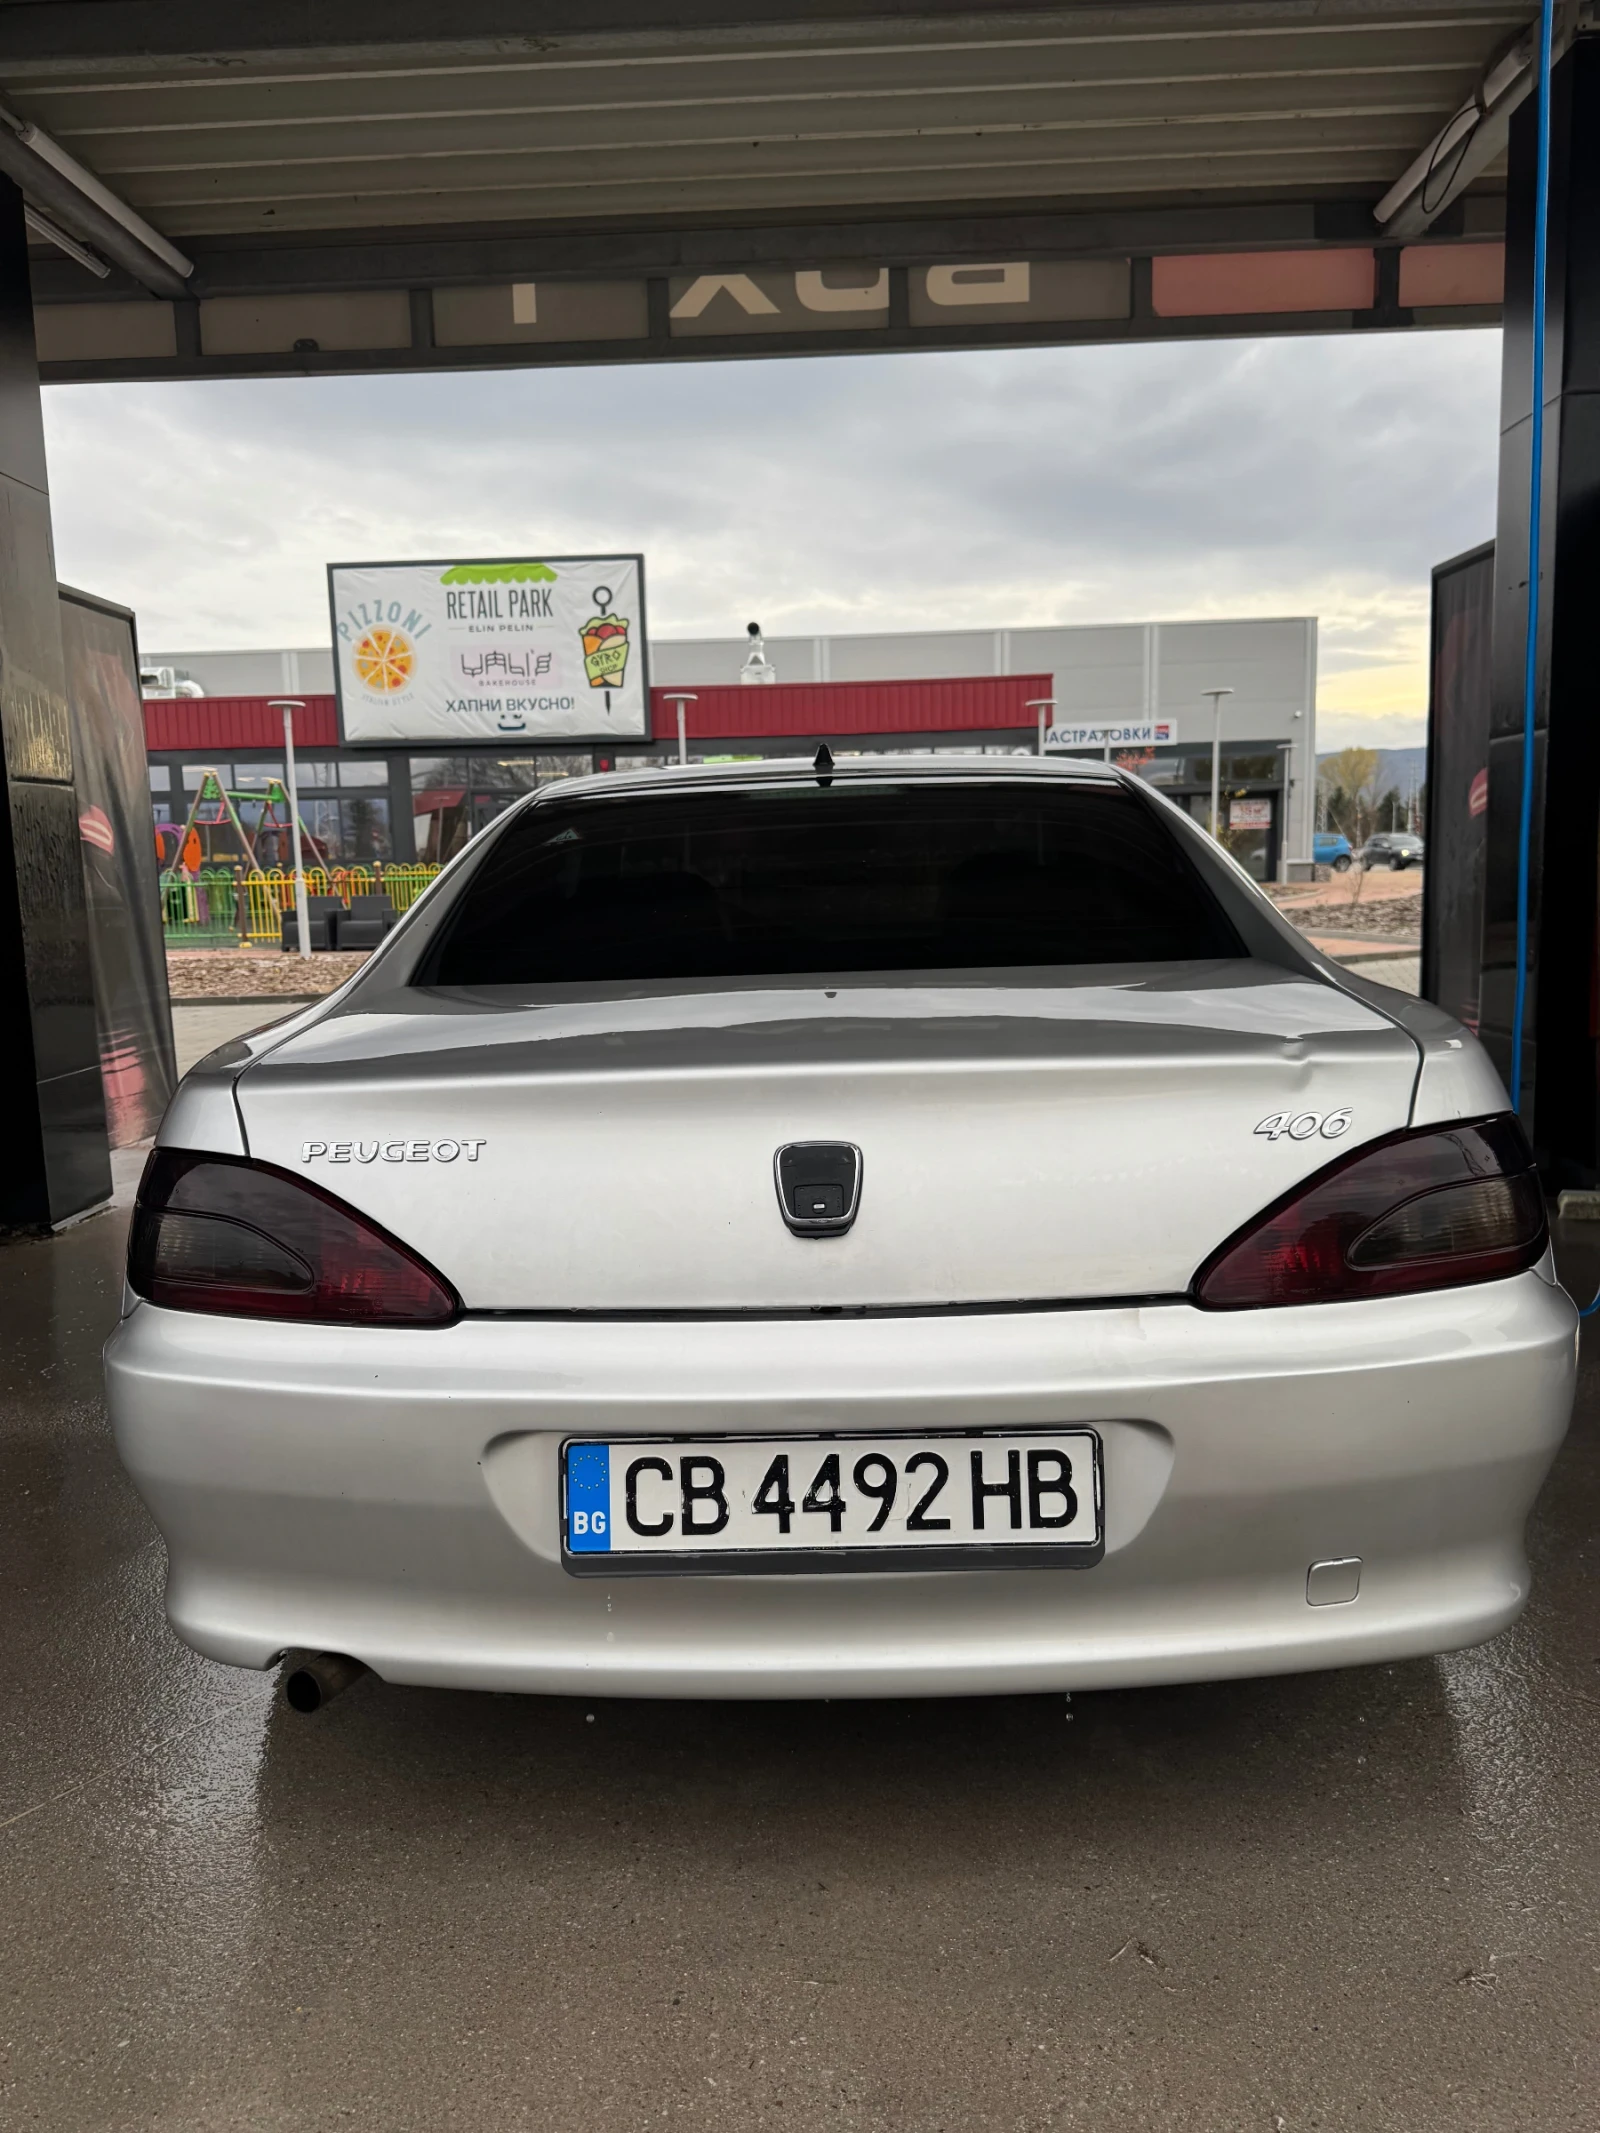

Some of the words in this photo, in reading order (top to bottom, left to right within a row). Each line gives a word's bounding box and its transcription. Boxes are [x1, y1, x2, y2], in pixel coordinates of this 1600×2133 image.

[446, 589, 503, 620] RETAIL
[508, 588, 554, 618] PARK
[337, 599, 432, 642] PIZZONI
[468, 625, 495, 633] ELIN
[499, 624, 534, 632] PELIN
[591, 650, 621, 667] GYRO
[478, 679, 537, 687] BAKEHOUSE
[445, 699, 502, 713] ХАПНИ
[506, 697, 575, 711] ВКУСНО!
[1044, 727, 1152, 744] АСТРАХОВКИ
[1253, 1107, 1353, 1140] 406
[302, 1139, 486, 1163] PEUGEOT
[625, 1455, 730, 1537] CB
[750, 1451, 951, 1534] 4492
[970, 1449, 1079, 1530] HB
[573, 1511, 607, 1535] BG
